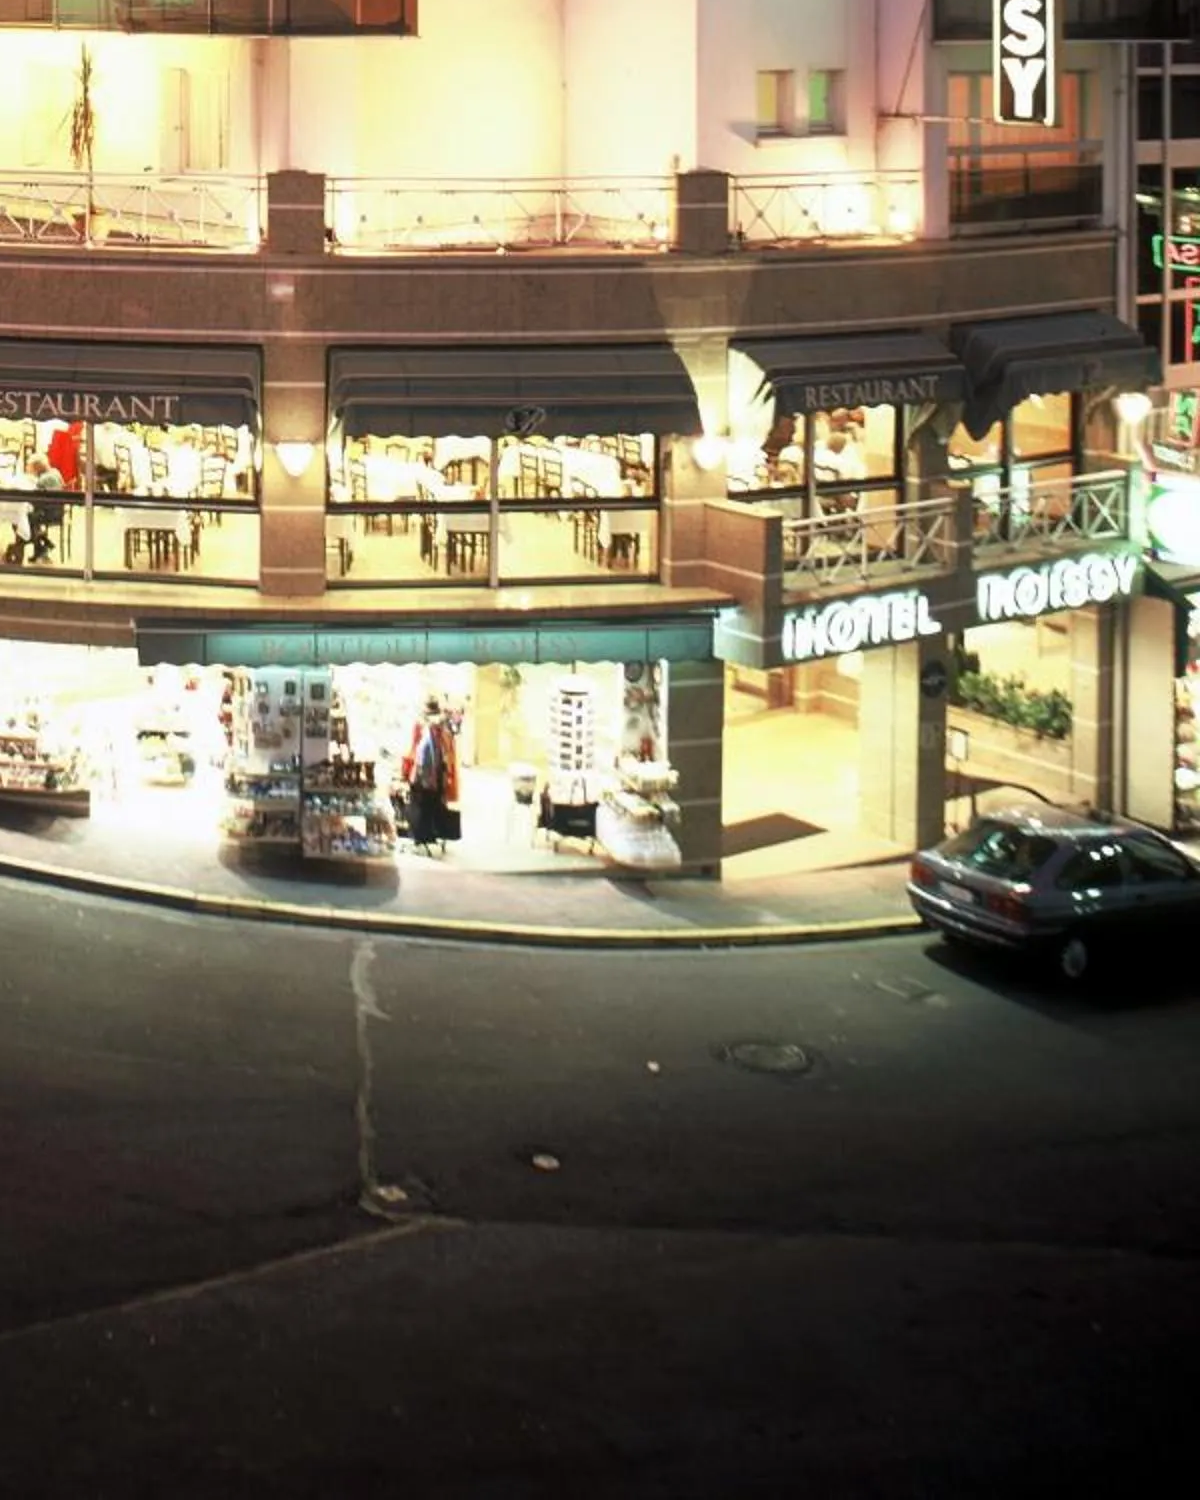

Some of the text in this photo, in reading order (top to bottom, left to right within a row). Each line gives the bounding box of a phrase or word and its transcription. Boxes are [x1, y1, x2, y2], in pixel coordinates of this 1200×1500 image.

[804, 374, 939, 408] RESTAURANT
[977, 553, 1137, 620] ROISSY
[782, 589, 942, 660] HOTEL
